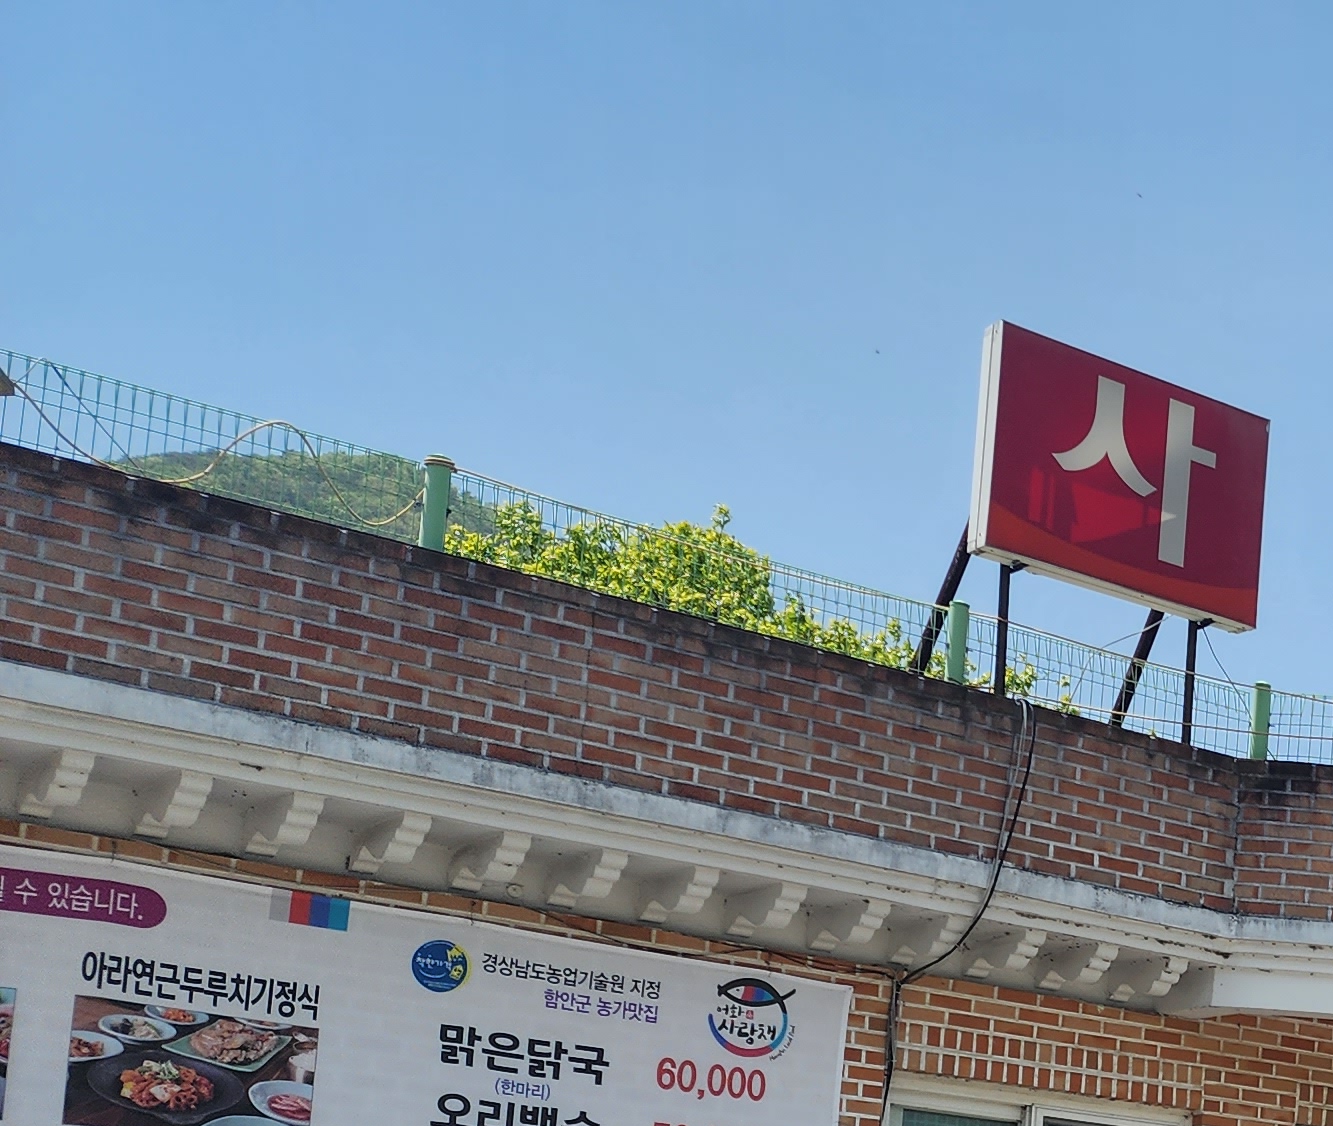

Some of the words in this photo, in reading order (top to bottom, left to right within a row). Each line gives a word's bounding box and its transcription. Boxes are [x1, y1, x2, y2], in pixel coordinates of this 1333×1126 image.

[1052, 375, 1217, 567] 사
[14, 878, 37, 905] 수
[48, 882, 143, 920] 있습니다.
[81, 950, 319, 1020] 아라연근두루치기정식
[482, 952, 625, 994] 경상남도농업기술원
[630, 979, 661, 1000] 지정
[544, 989, 591, 1013] 함안군
[596, 998, 658, 1023] 농가맛집
[718, 1019, 776, 1045] 사랑채
[438, 1023, 609, 1085] 맑은닭국
[656, 1057, 766, 1101] 60,000
[494, 1078, 551, 1100] (한마리)
